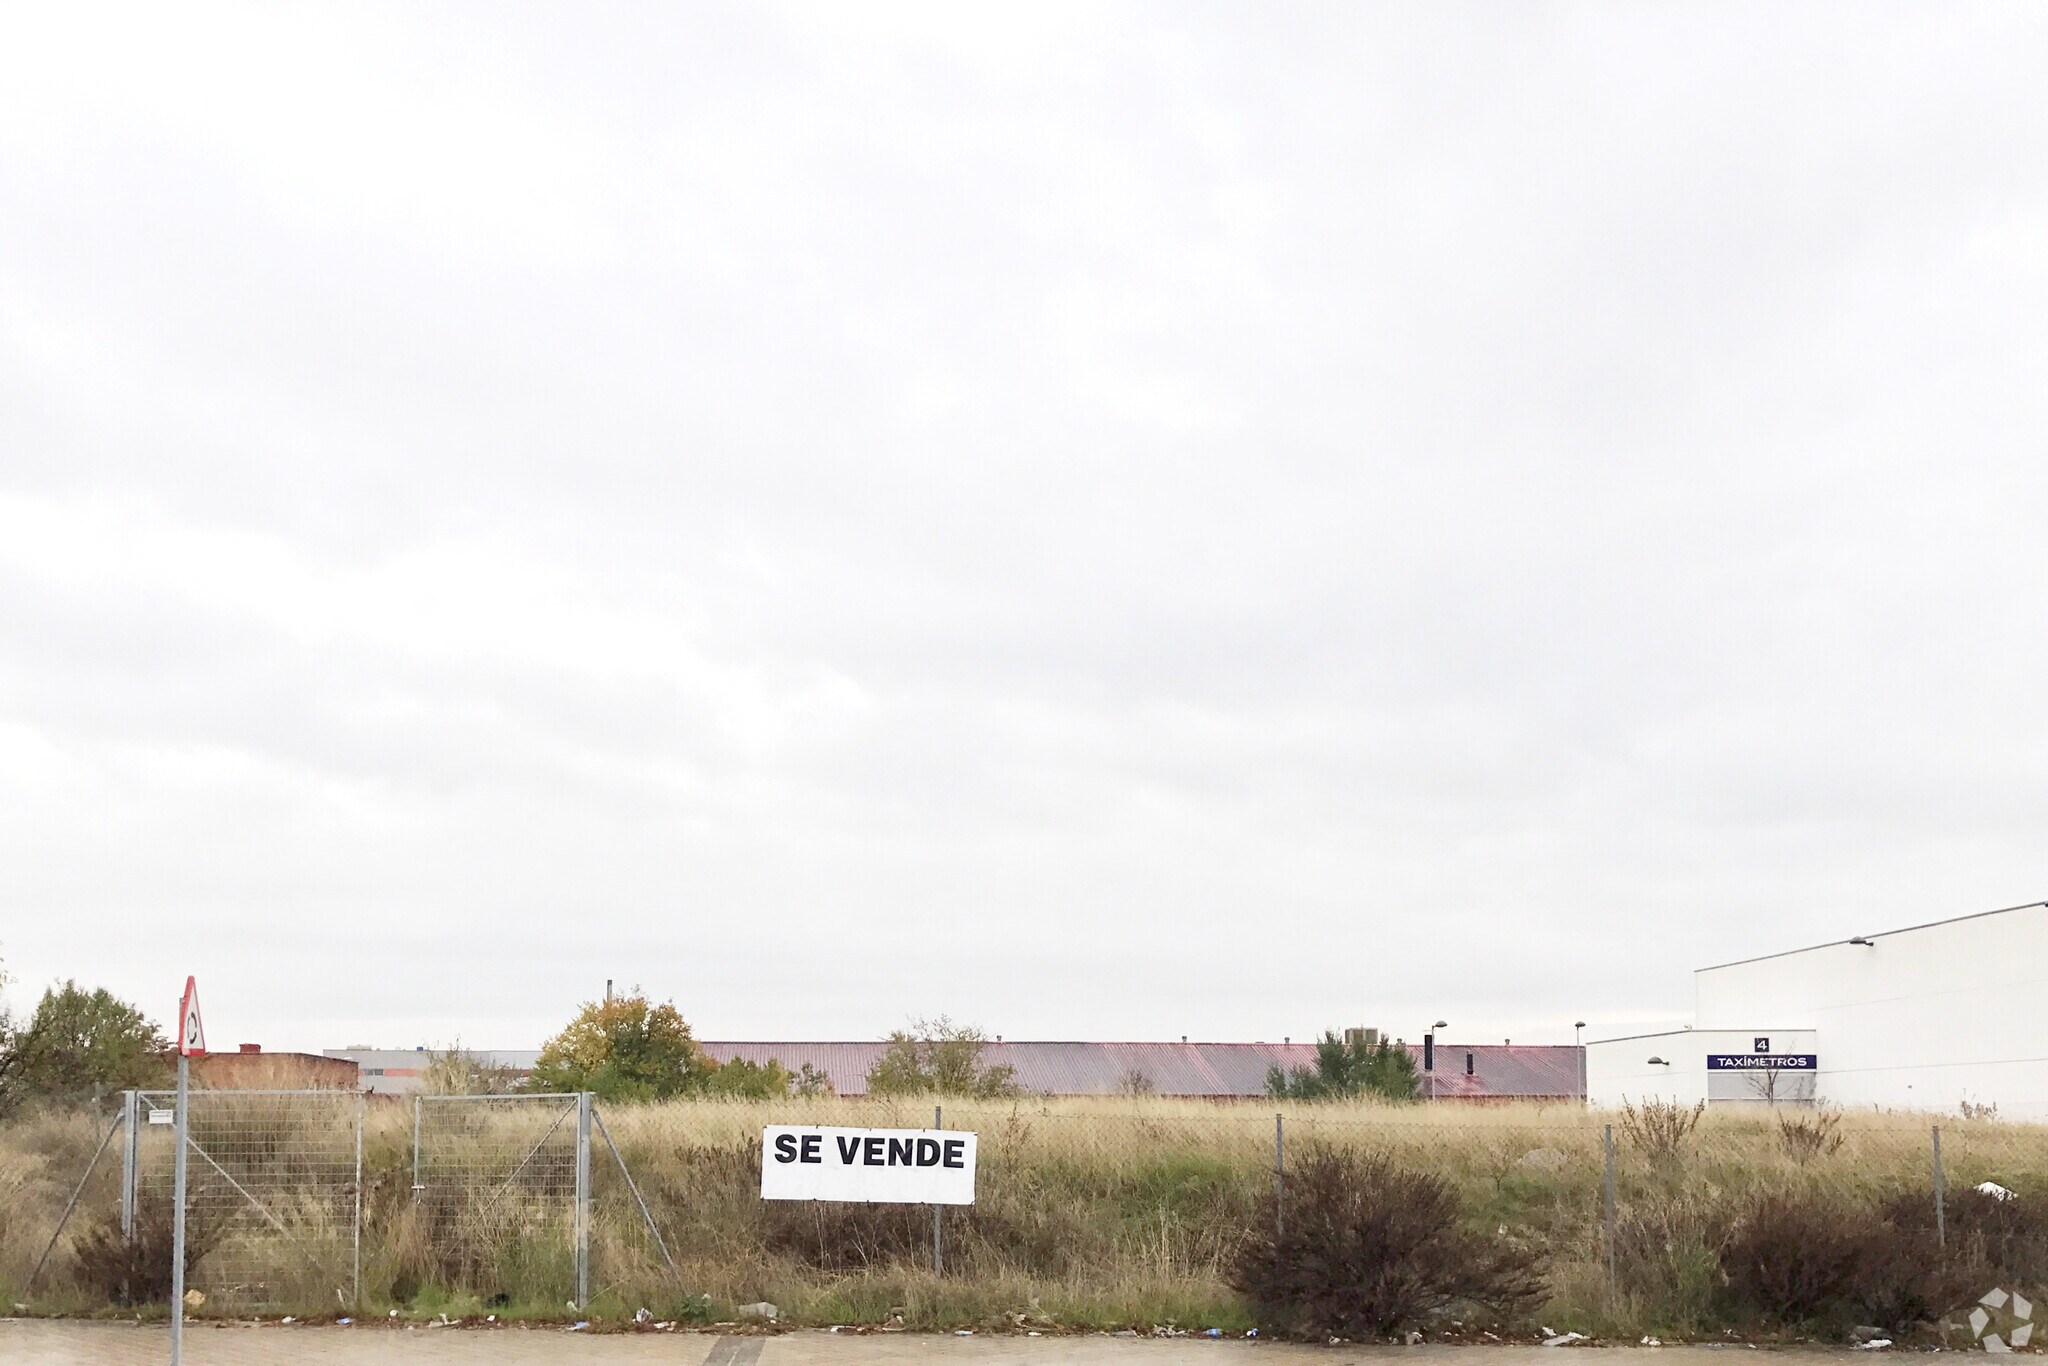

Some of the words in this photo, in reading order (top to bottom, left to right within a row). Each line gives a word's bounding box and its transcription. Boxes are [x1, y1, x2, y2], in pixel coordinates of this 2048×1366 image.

[1756, 1040, 1768, 1050] 4
[1717, 1055, 1807, 1067] TAXÍMETROS
[774, 1133, 823, 1164] SE
[836, 1135, 966, 1169] VENDE
